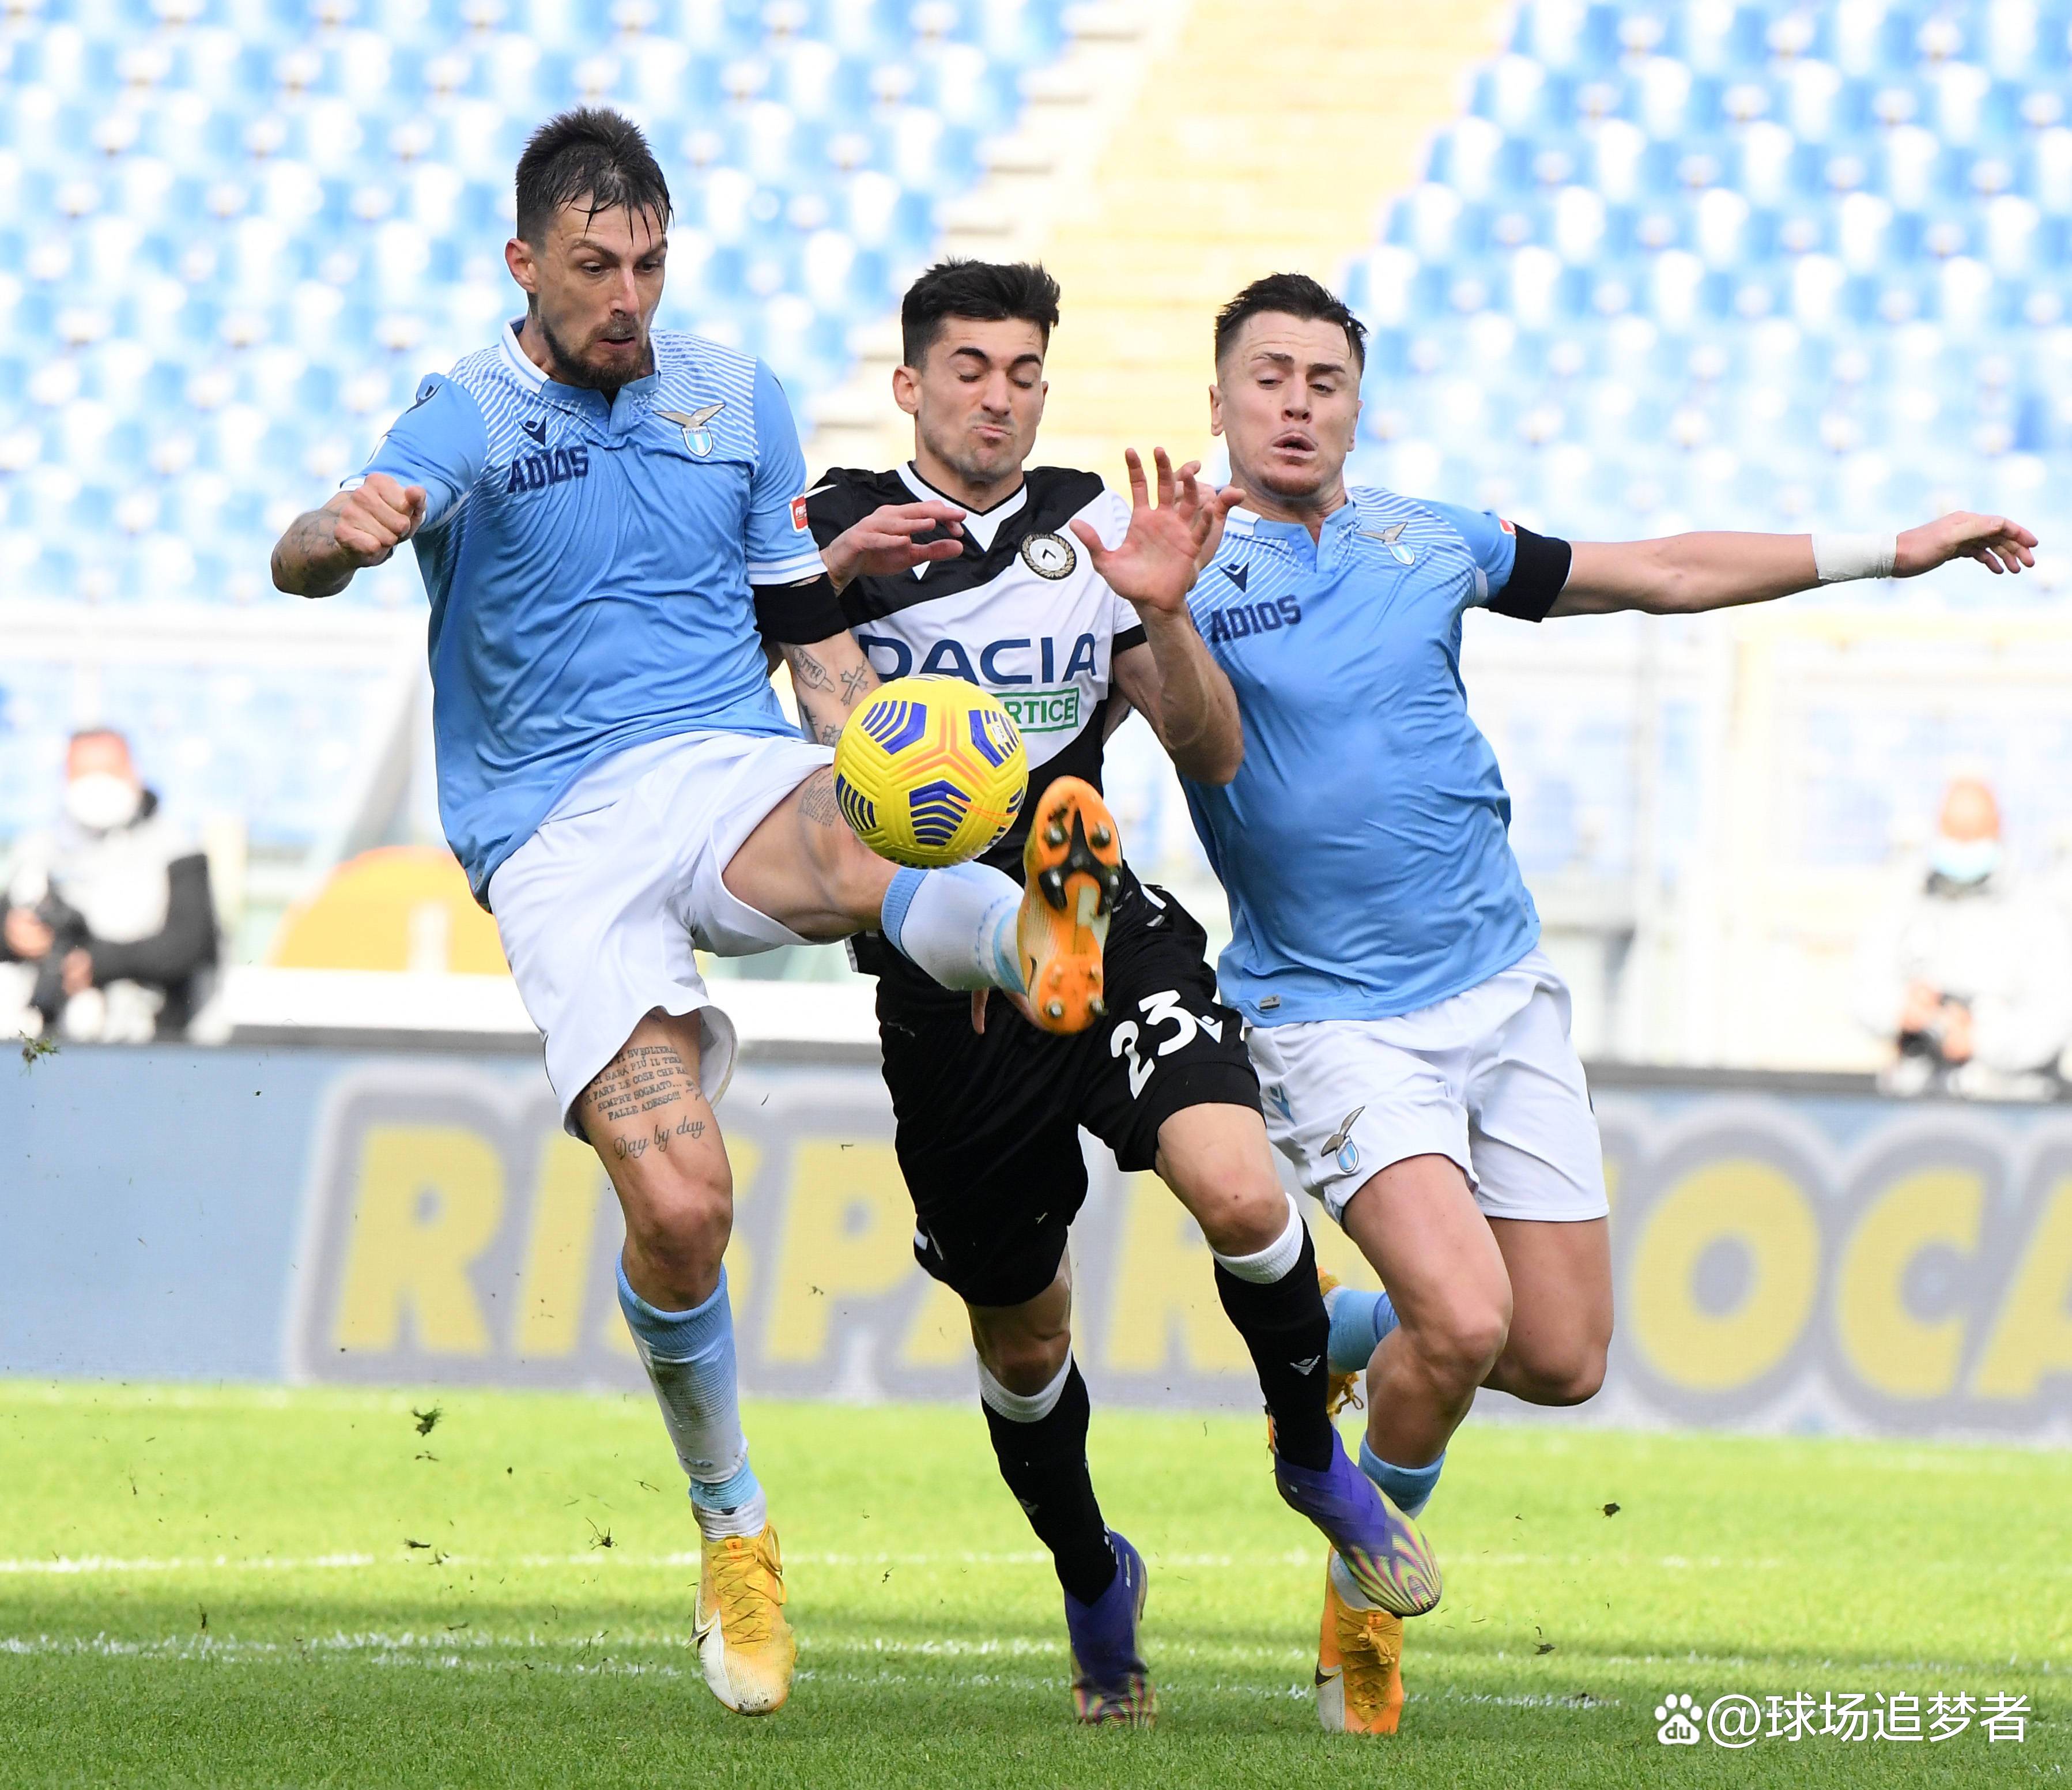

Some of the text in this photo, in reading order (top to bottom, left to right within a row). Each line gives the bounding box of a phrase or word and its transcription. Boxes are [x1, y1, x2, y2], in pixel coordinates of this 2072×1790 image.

[859, 632, 1097, 685] DACIA
[1004, 697, 1076, 724] RTICE
[1110, 989, 1197, 1100] 23
[593, 1084, 616, 1101] FARE
[618, 1079, 631, 1090] LE
[633, 1071, 654, 1084] COSE
[657, 1068, 674, 1077] CHE
[598, 1094, 632, 1111] SEMPRE
[608, 1106, 639, 1121] FALLE
[614, 1115, 705, 1160] Day by day
